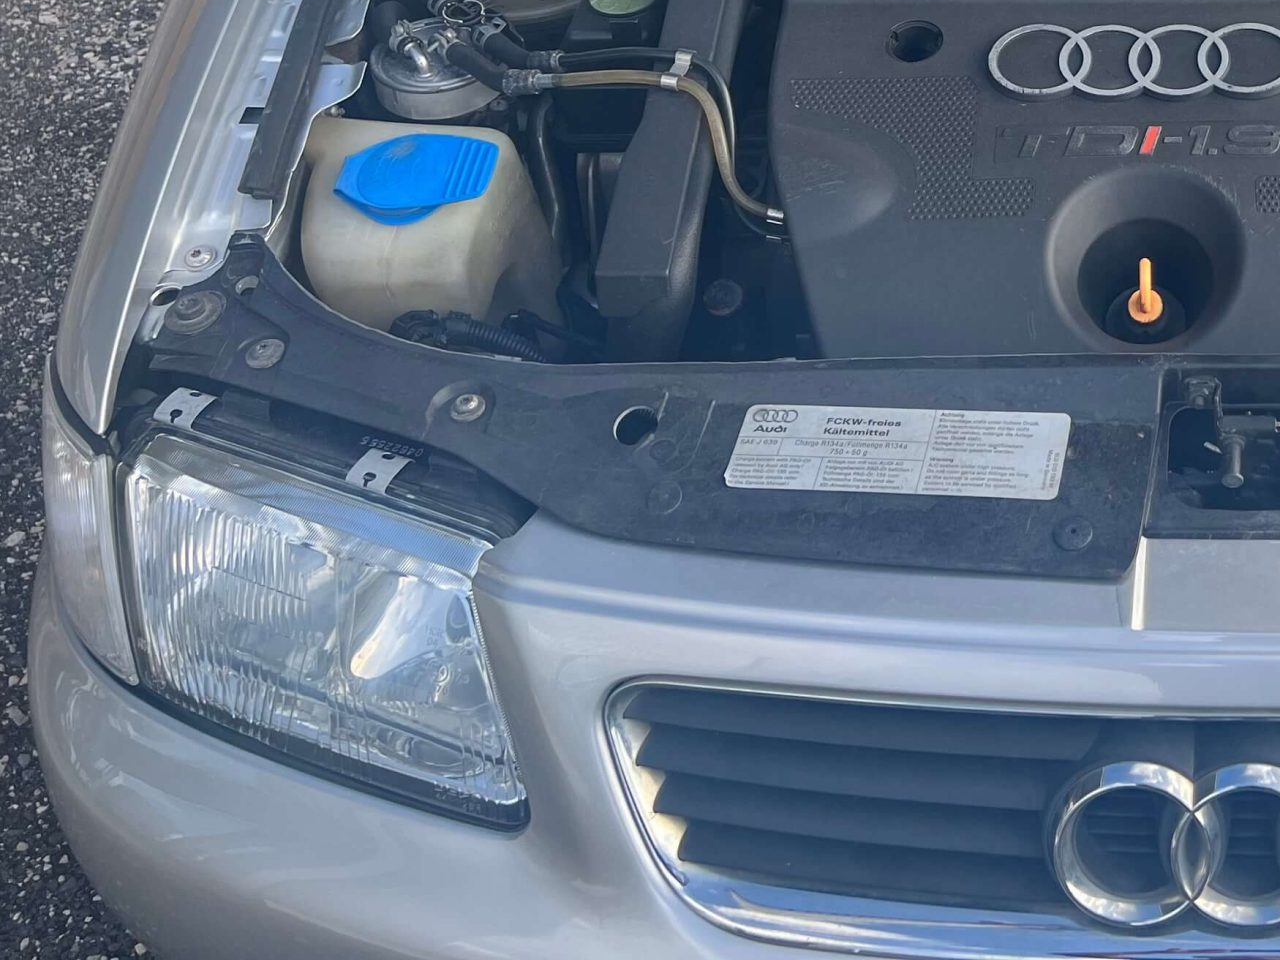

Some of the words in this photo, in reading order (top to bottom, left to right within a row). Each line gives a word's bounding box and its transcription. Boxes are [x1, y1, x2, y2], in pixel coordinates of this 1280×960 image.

[825, 417, 903, 428] FCKW-freies
[753, 424, 788, 434] Audi
[822, 427, 890, 438] Kältemittel
[794, 439, 820, 449] Charge
[829, 448, 844, 456] 750
